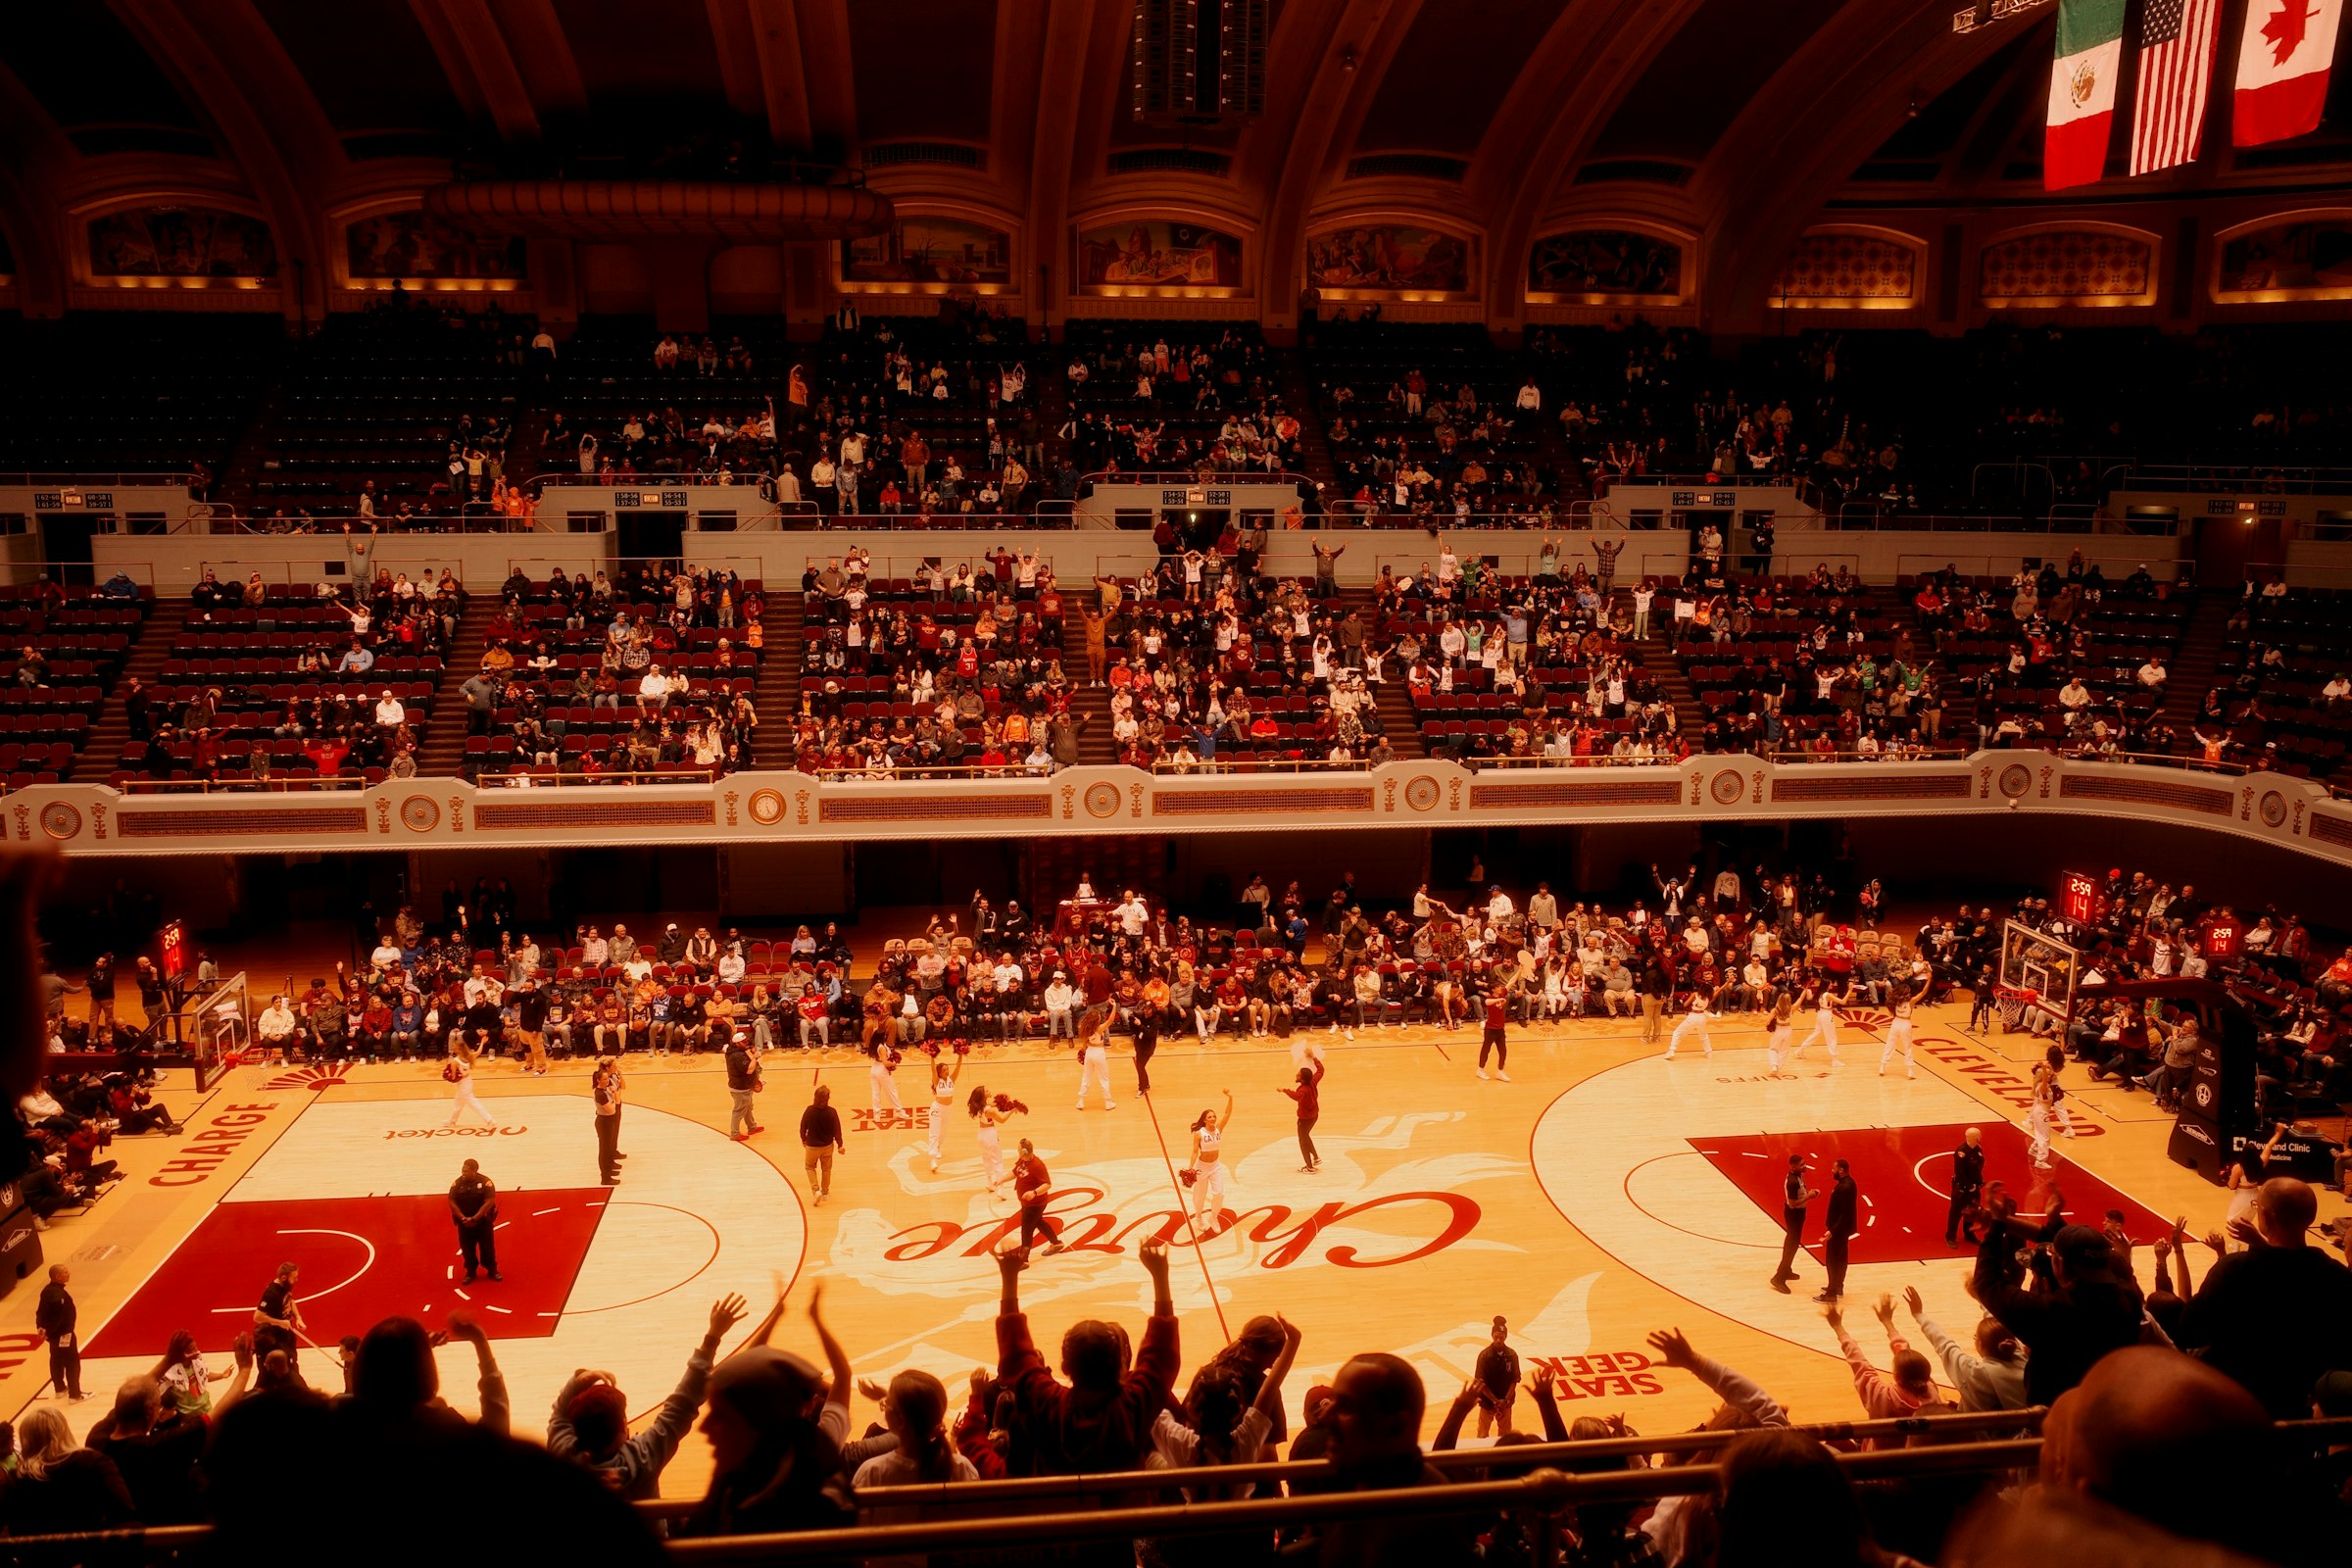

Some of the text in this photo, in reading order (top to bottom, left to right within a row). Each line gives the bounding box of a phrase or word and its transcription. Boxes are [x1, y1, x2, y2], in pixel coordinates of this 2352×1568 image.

[2071, 878, 2091, 897] 2:59
[2072, 895, 2087, 920] 14
[165, 927, 180, 950] 2:59
[2212, 927, 2232, 939] 2:59
[2215, 941, 2228, 952] 14
[1715, 1074, 1798, 1084] CLIFFS
[382, 1126, 497, 1140] Rocket
[851, 1117, 930, 1132] SEAT
[148, 1102, 280, 1187] CHARGE
[2288, 1143, 2311, 1153] Clinic
[883, 1186, 1483, 1270] Charge
[1526, 1351, 1651, 1377] GEEK
[1554, 1373, 1664, 1401] SEAT
